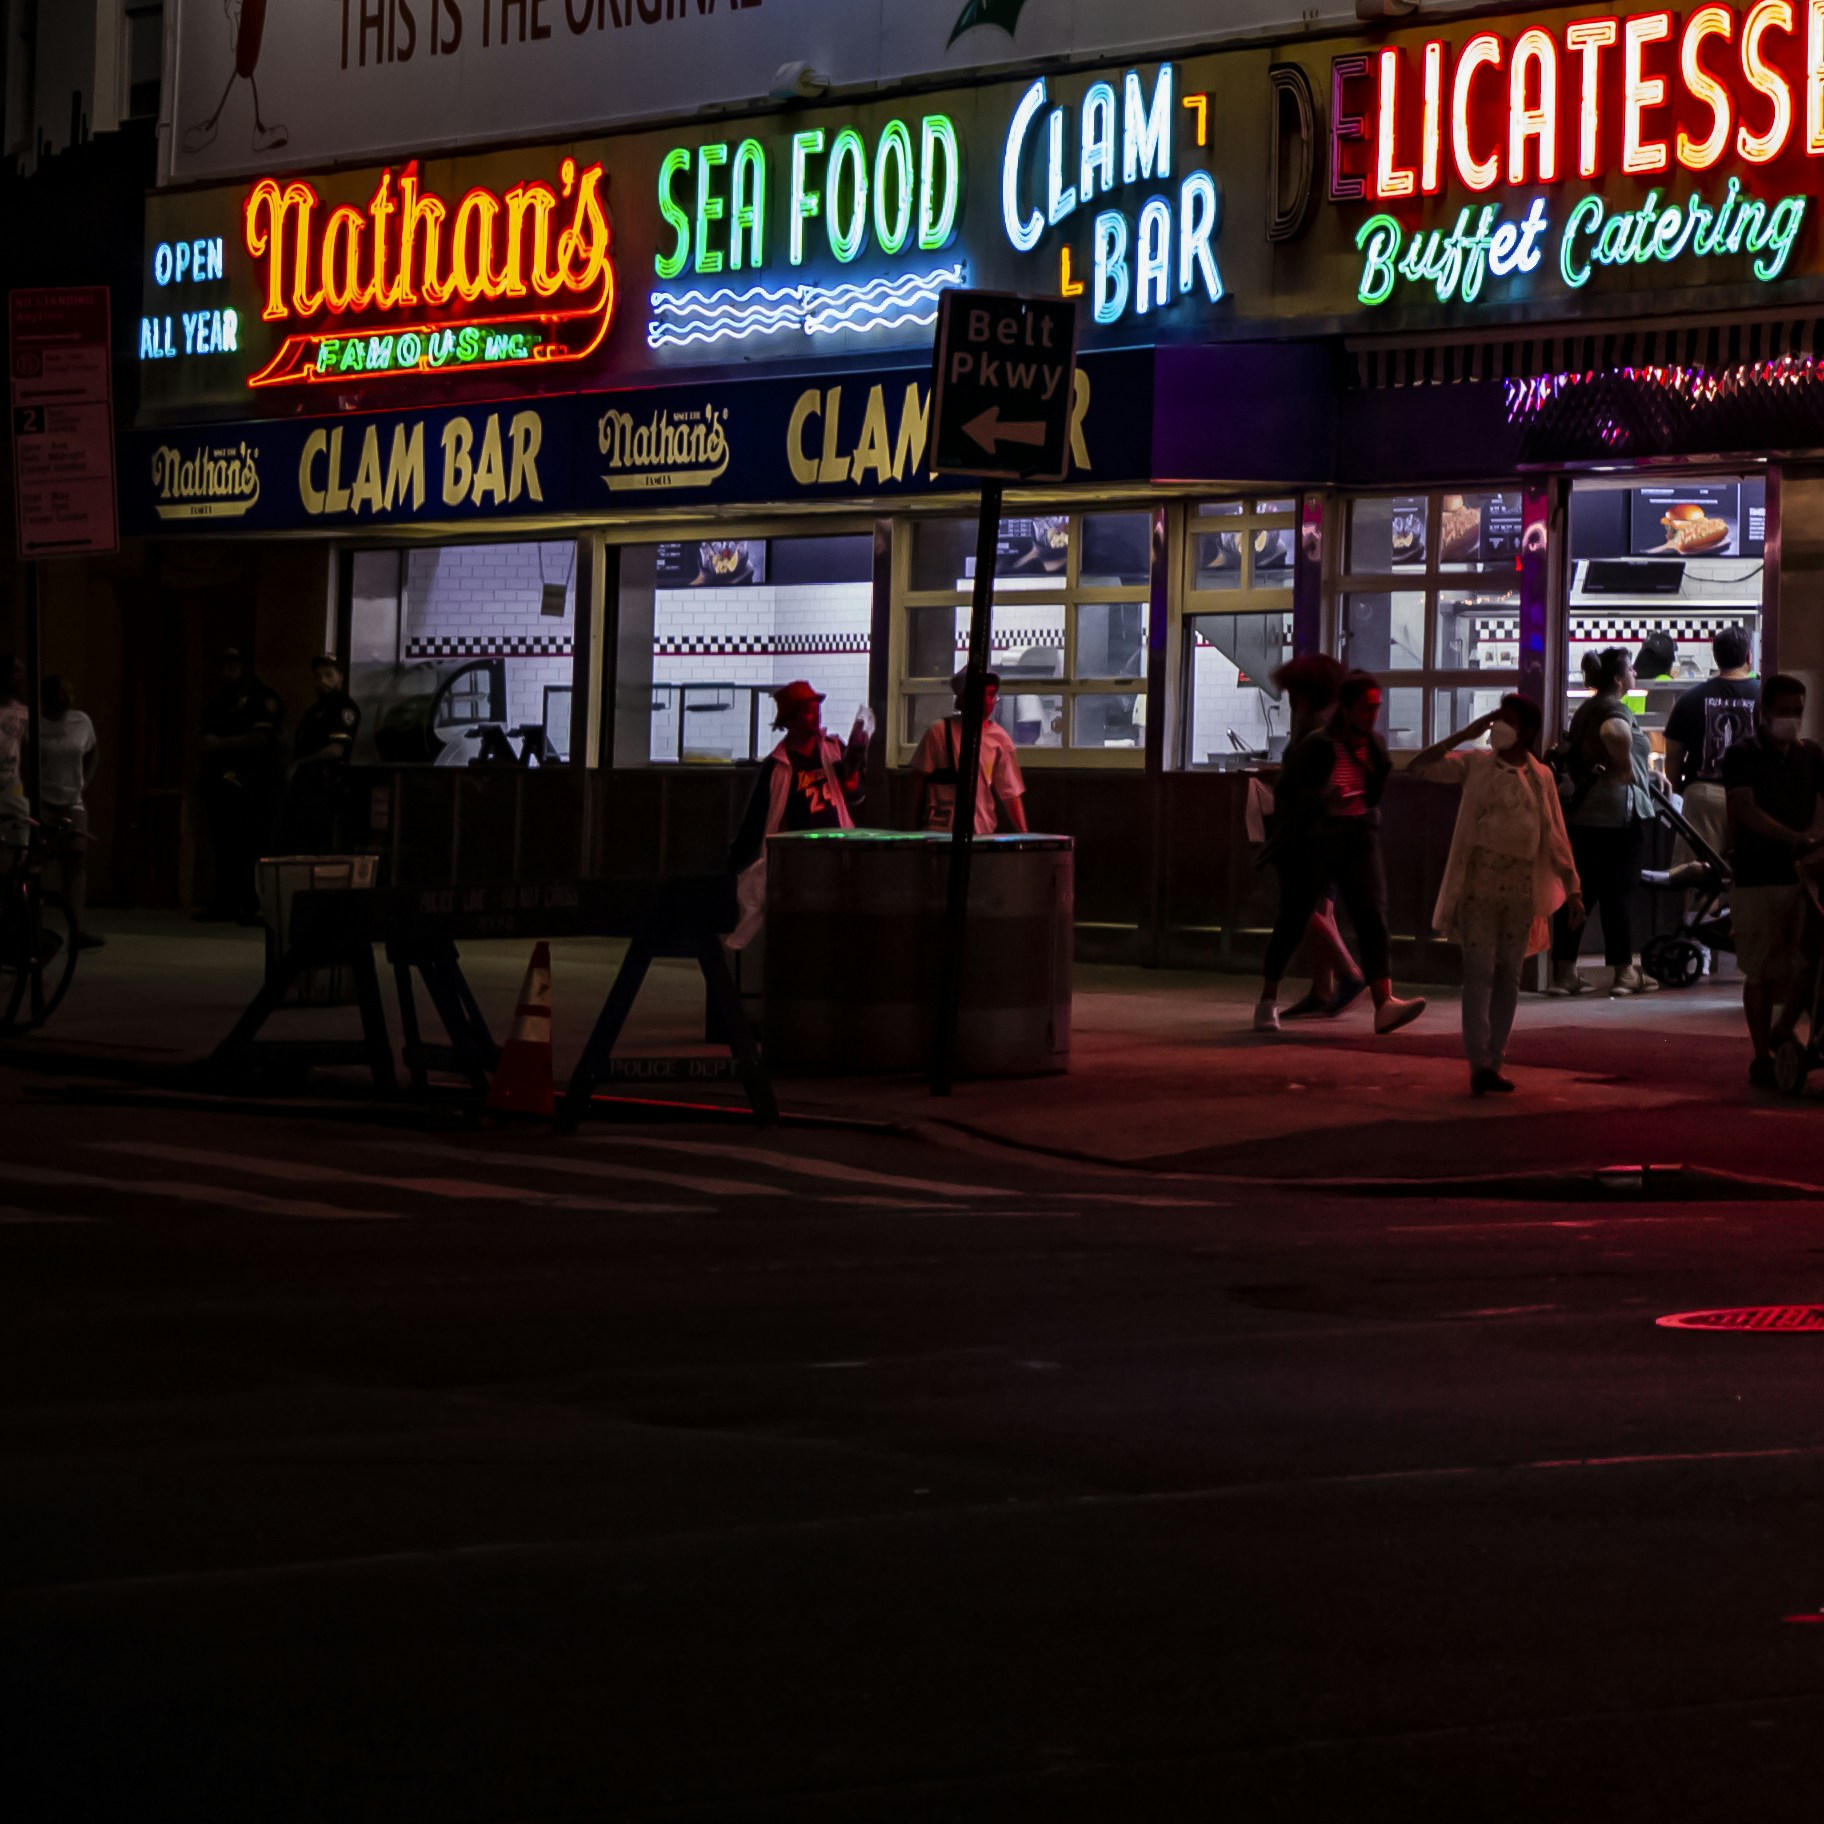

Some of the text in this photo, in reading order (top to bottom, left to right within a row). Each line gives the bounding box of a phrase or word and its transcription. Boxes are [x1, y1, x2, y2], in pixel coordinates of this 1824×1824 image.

[1002, 62, 1175, 253] CLAM
[654, 111, 960, 280] SEA FOOD
[153, 235, 225, 287] OPEN
[244, 157, 614, 324] Nathan's
[1093, 168, 1225, 325] BAR
[1354, 176, 1807, 307] Buffet Catering
[139, 306, 239, 361] ALL YEAR
[316, 326, 479, 373] FAMOUS
[967, 308, 1055, 349] Belt
[951, 350, 1065, 402] Pkwy
[299, 409, 544, 515] CLAM BAR
[598, 402, 730, 468] Nathan's
[150, 440, 260, 499] Nathan's
[609, 1058, 740, 1077] POLICE DEPT
